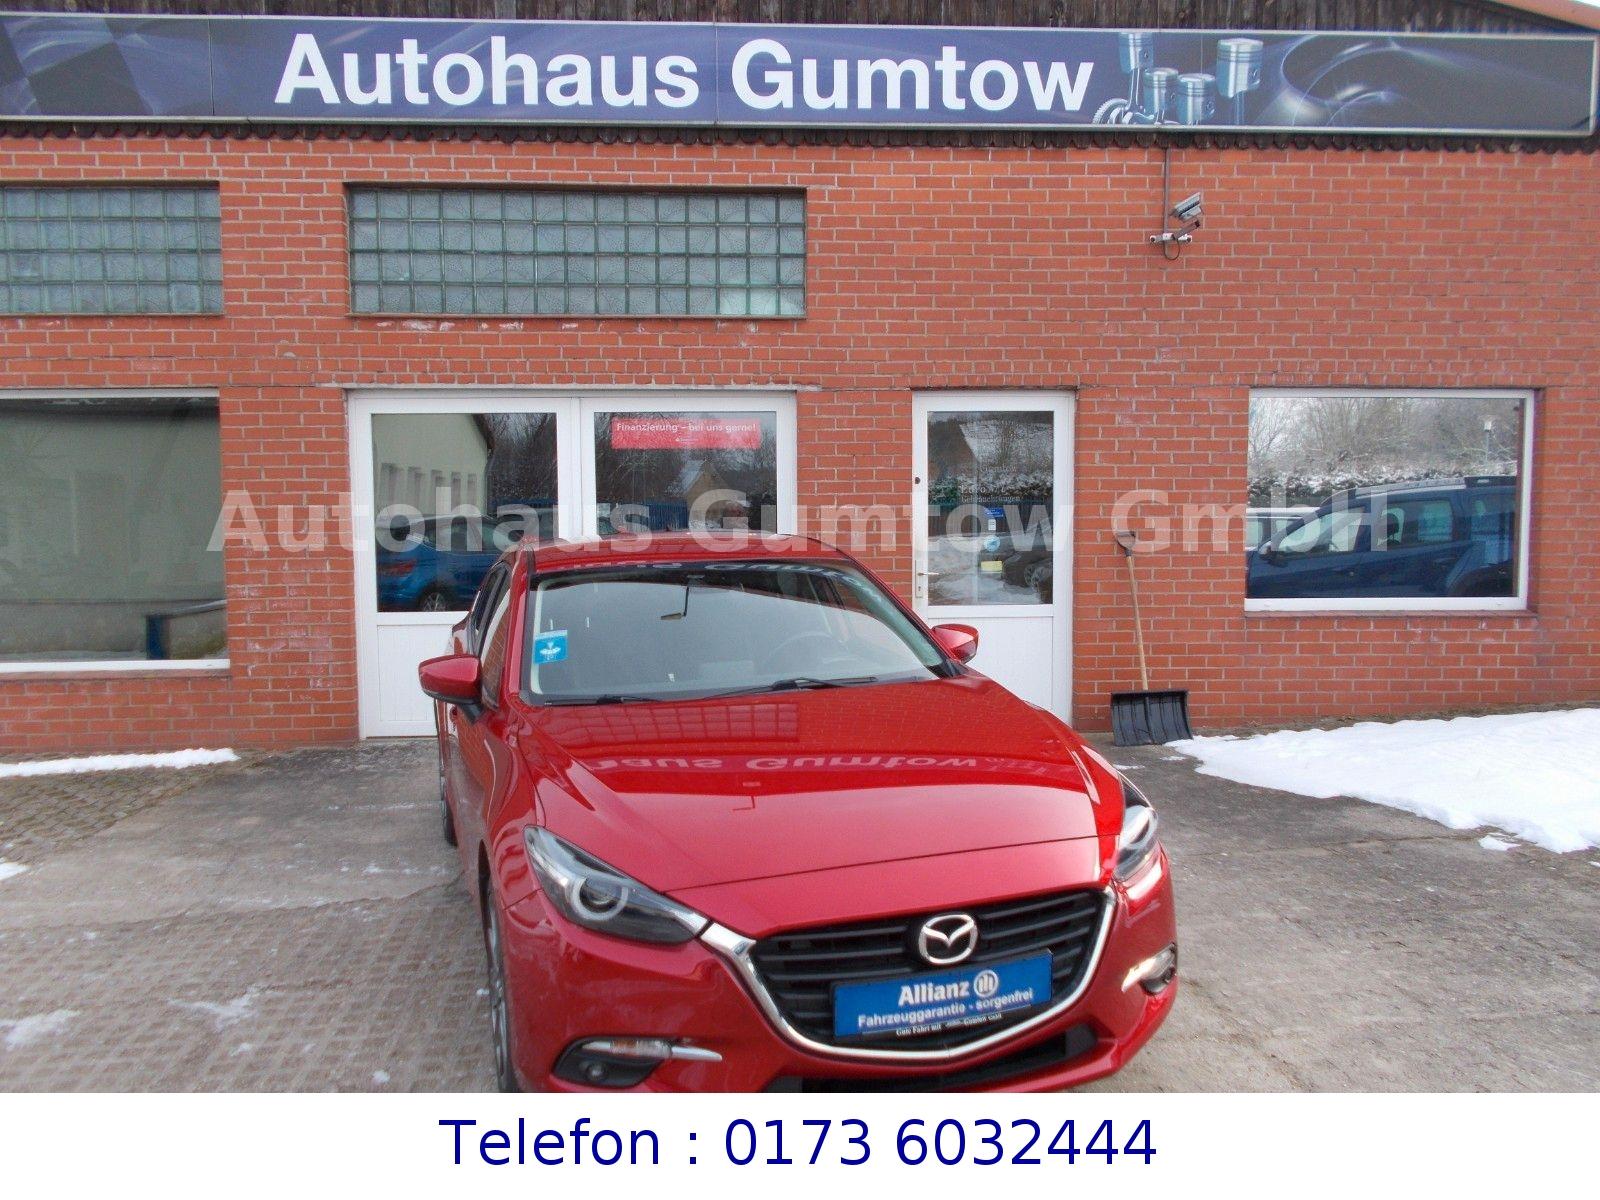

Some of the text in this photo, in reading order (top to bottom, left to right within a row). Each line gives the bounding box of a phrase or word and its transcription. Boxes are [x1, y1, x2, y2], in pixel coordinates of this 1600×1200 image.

[275, 34, 1094, 111] Autohaus Gumtow
[616, 423, 678, 433] Finanzierung
[689, 422, 704, 431] bei
[725, 423, 757, 433] gerne!
[858, 1003, 965, 1028] Fahrzeuggarantie
[976, 987, 1033, 1011] sorgenfrei
[899, 980, 969, 1006] Allianz
